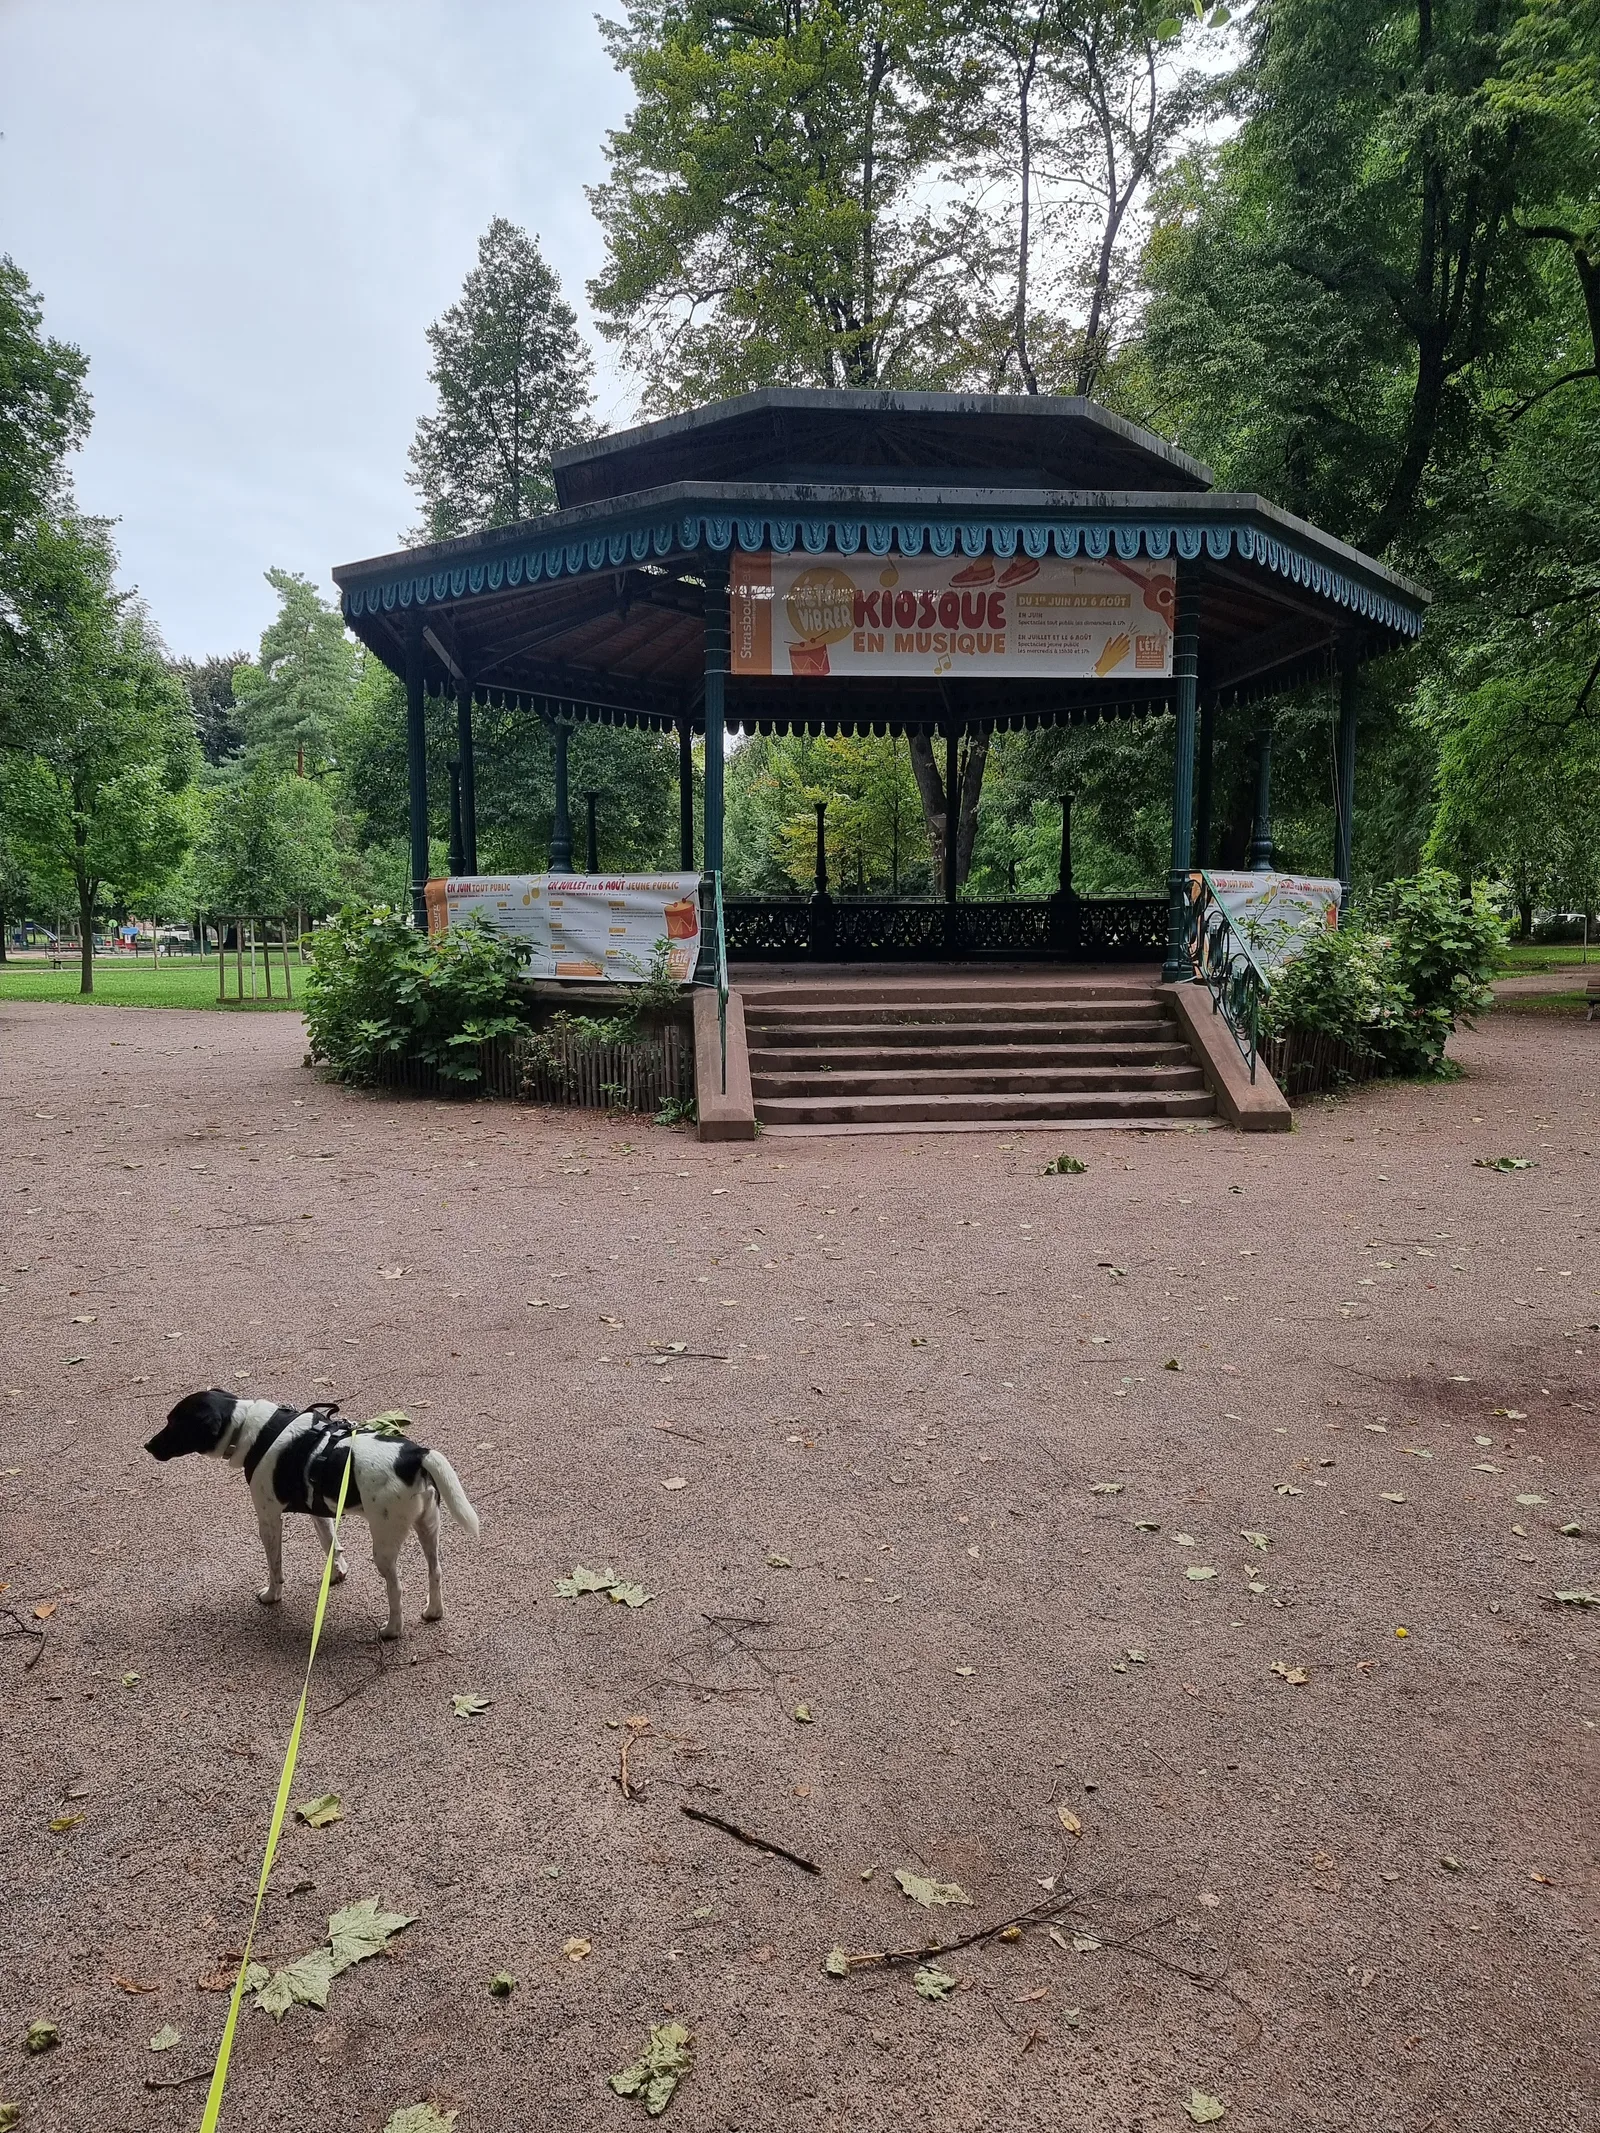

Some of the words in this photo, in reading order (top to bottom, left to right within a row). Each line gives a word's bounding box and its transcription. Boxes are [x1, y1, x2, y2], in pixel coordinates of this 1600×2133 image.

[1019, 596, 1032, 606] DU
[1048, 597, 1071, 606] JUIN
[1074, 597, 1088, 606] AU
[1090, 597, 1097, 606] 6
[1099, 595, 1127, 607] AOÛT
[853, 590, 1007, 631] KIOSQUE
[853, 632, 885, 653] EN
[894, 632, 1006, 656] MUSIQUE
[447, 883, 456, 893] EN
[456, 883, 471, 893] JUIN
[472, 884, 489, 892] TOUT
[489, 883, 511, 892] PUBLIC
[558, 881, 587, 890] JUILLET
[598, 881, 604, 890] 6
[626, 882, 650, 890] JEUNE
[652, 881, 679, 890] PUBLIC
